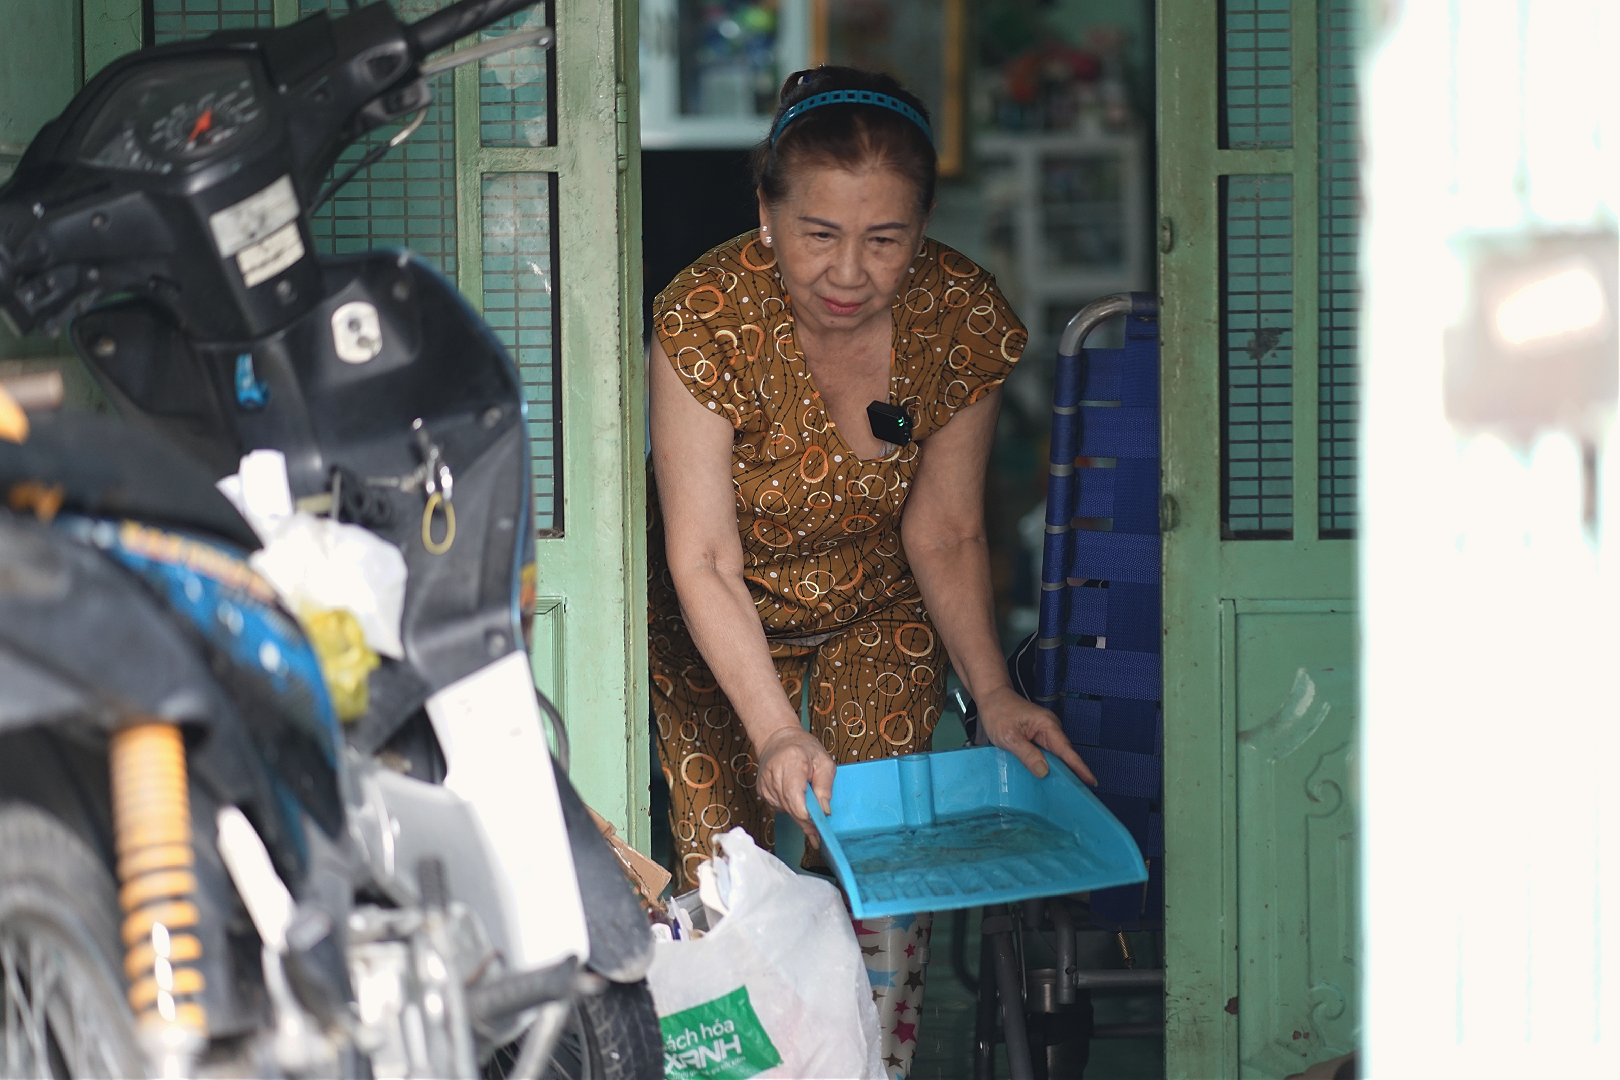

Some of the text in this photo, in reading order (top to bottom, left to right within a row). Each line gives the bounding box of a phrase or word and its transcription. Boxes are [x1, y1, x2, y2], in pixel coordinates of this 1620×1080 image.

[664, 1018, 735, 1052] ách hóa
[664, 1033, 742, 1074] XANH
